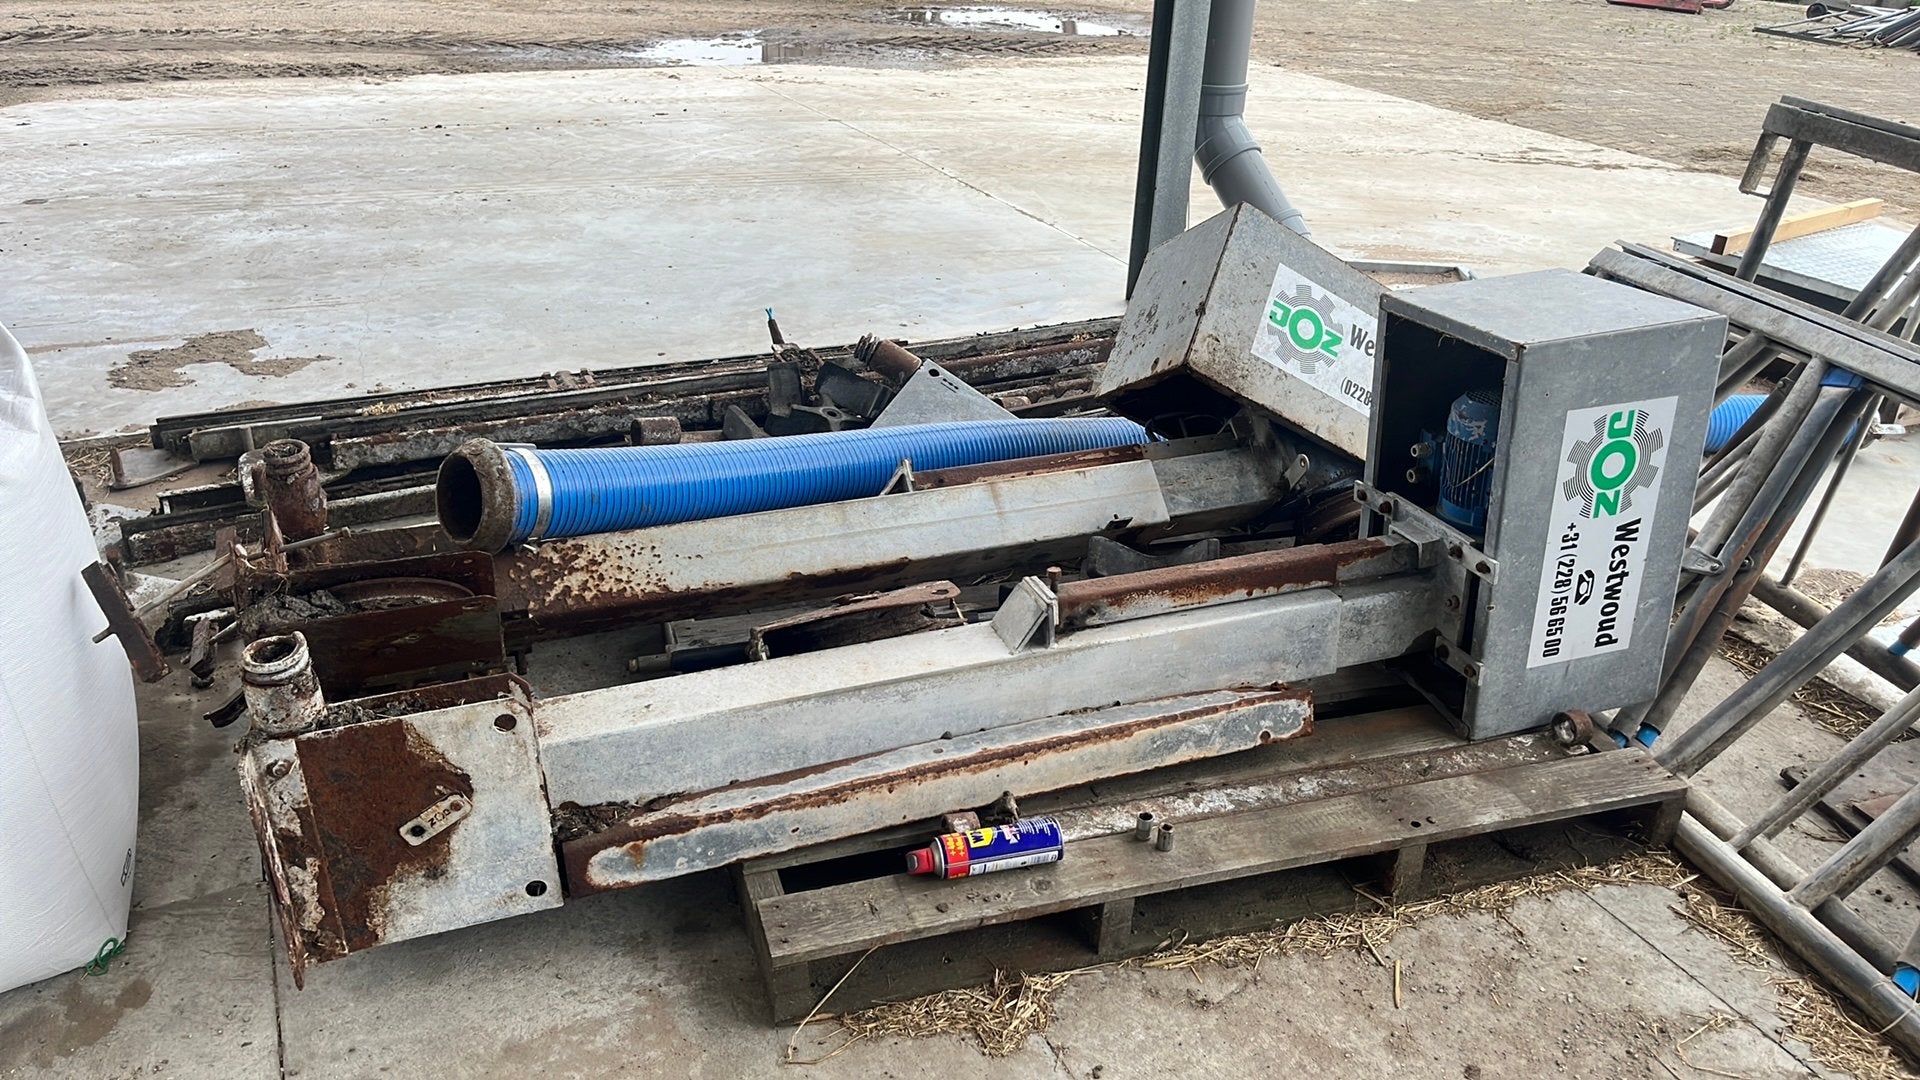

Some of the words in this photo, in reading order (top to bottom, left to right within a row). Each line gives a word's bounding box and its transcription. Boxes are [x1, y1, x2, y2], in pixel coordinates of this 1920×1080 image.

[1270, 300, 1343, 358] JOZ
[1350, 323, 1376, 357] We
[1341, 376, 1372, 407] (0228
[1591, 409, 1636, 519] JOZ
[1560, 522, 1580, 551] +31
[1551, 553, 1578, 594] (228)
[1594, 518, 1642, 648] Westwoud
